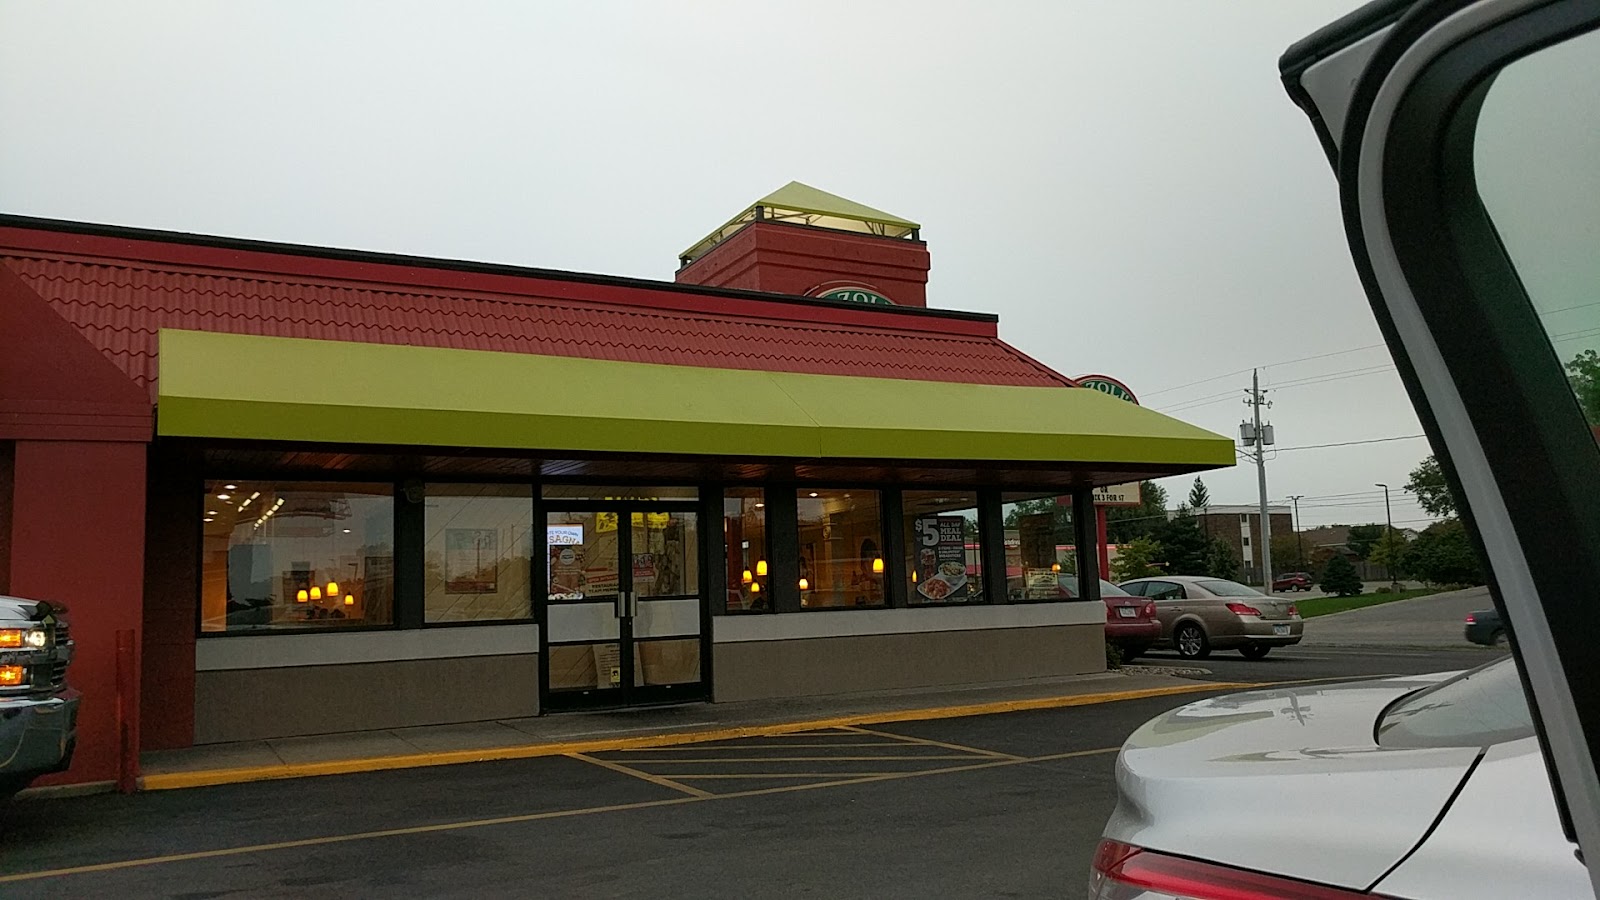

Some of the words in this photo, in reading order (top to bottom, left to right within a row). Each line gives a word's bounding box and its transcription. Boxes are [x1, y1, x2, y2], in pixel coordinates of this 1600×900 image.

[915, 518, 940, 546] $5
[940, 527, 962, 535] MEAL
[940, 534, 962, 542] DEAL
